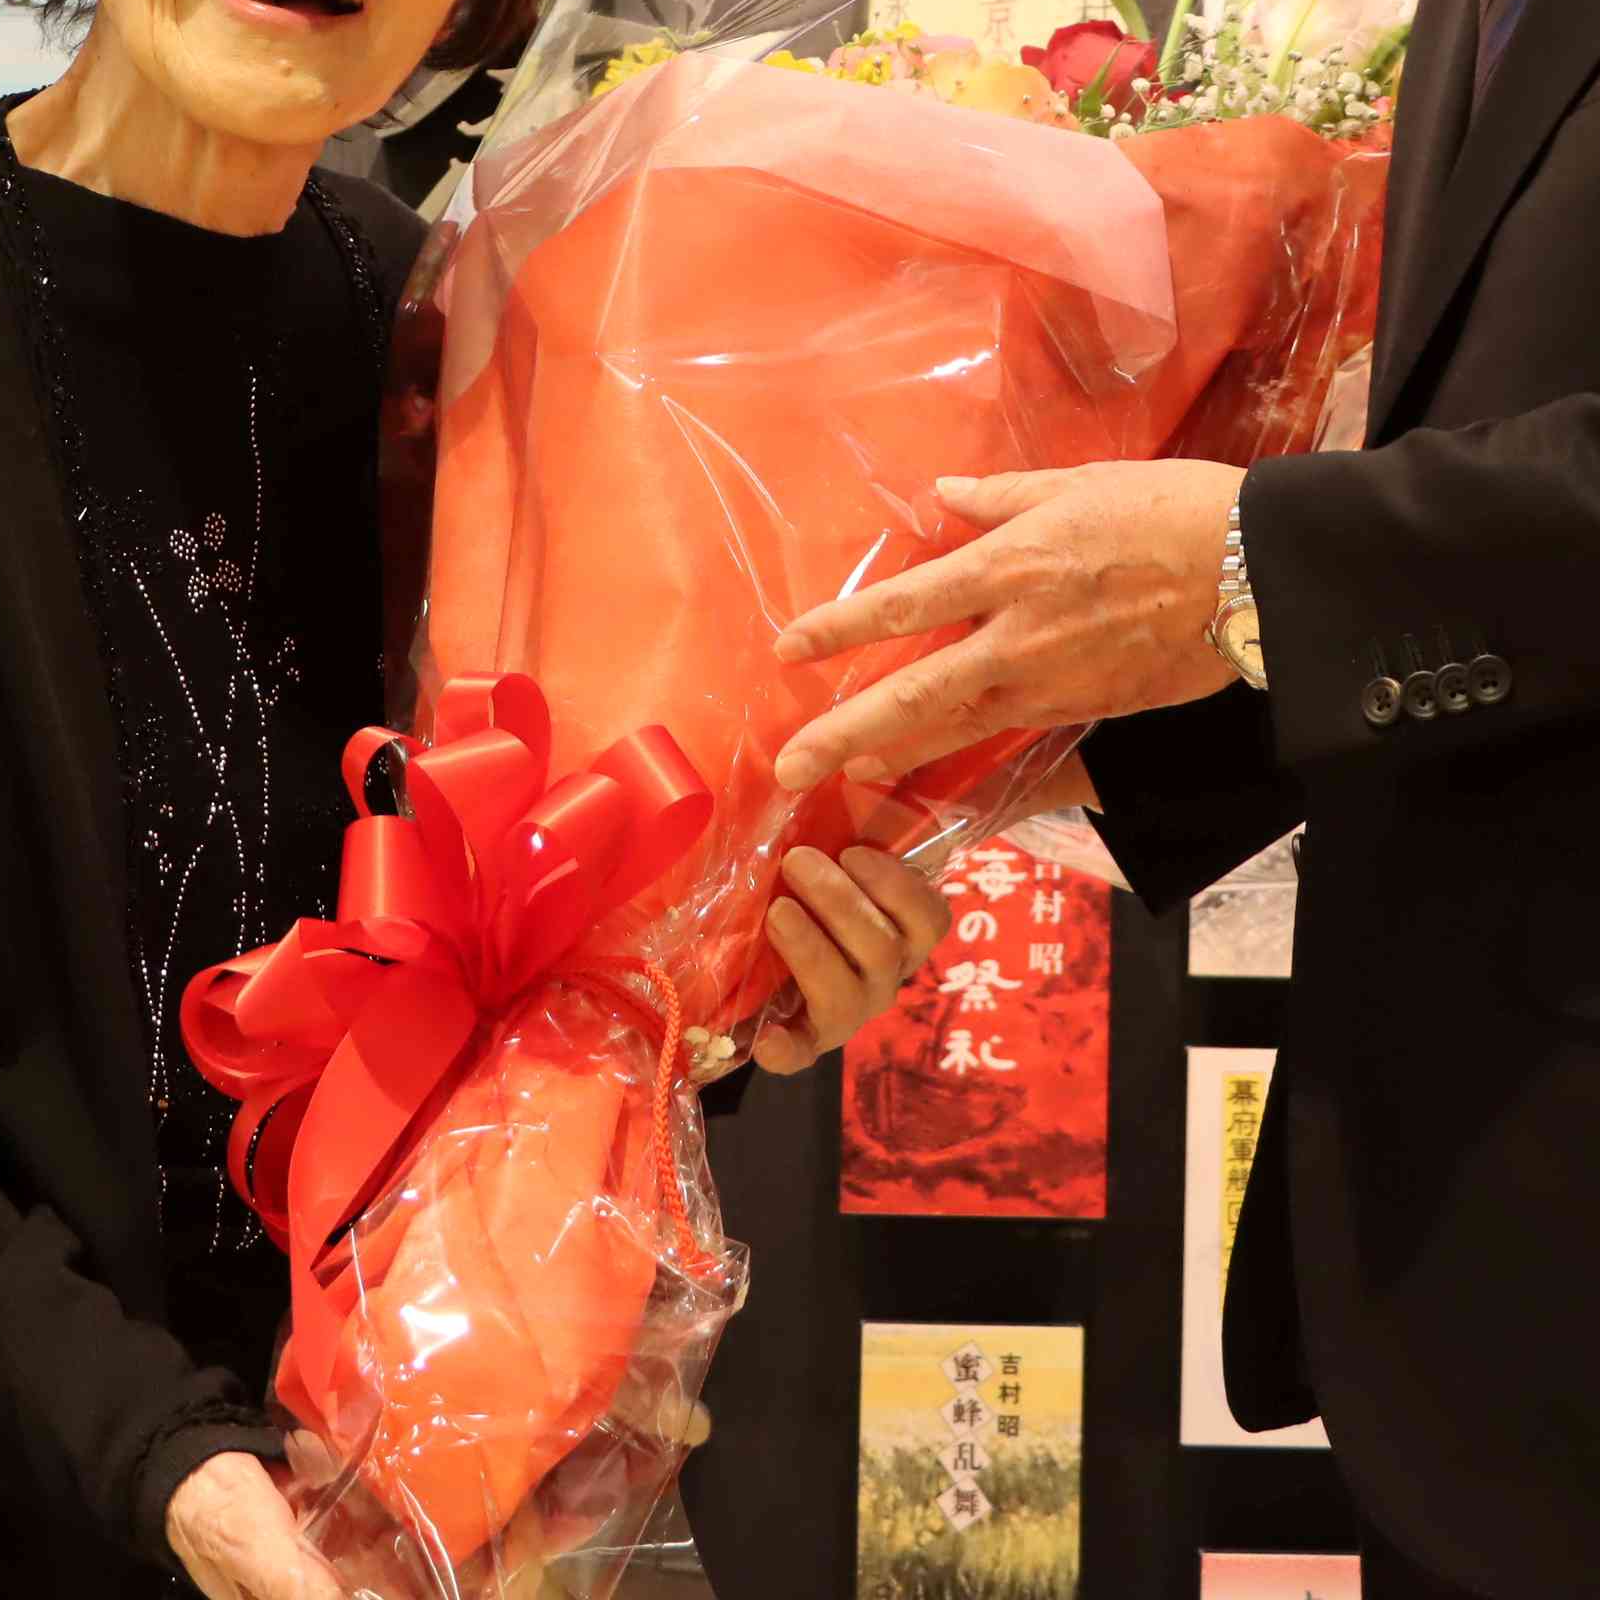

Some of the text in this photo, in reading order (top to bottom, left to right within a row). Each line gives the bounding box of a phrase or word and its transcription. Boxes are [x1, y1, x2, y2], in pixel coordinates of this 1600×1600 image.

[938, 849, 1029, 1075] 海の祭礼
[952, 1353, 983, 1519] 蜜蜂乱舞
[997, 1353, 1022, 1437] 吉村昭
